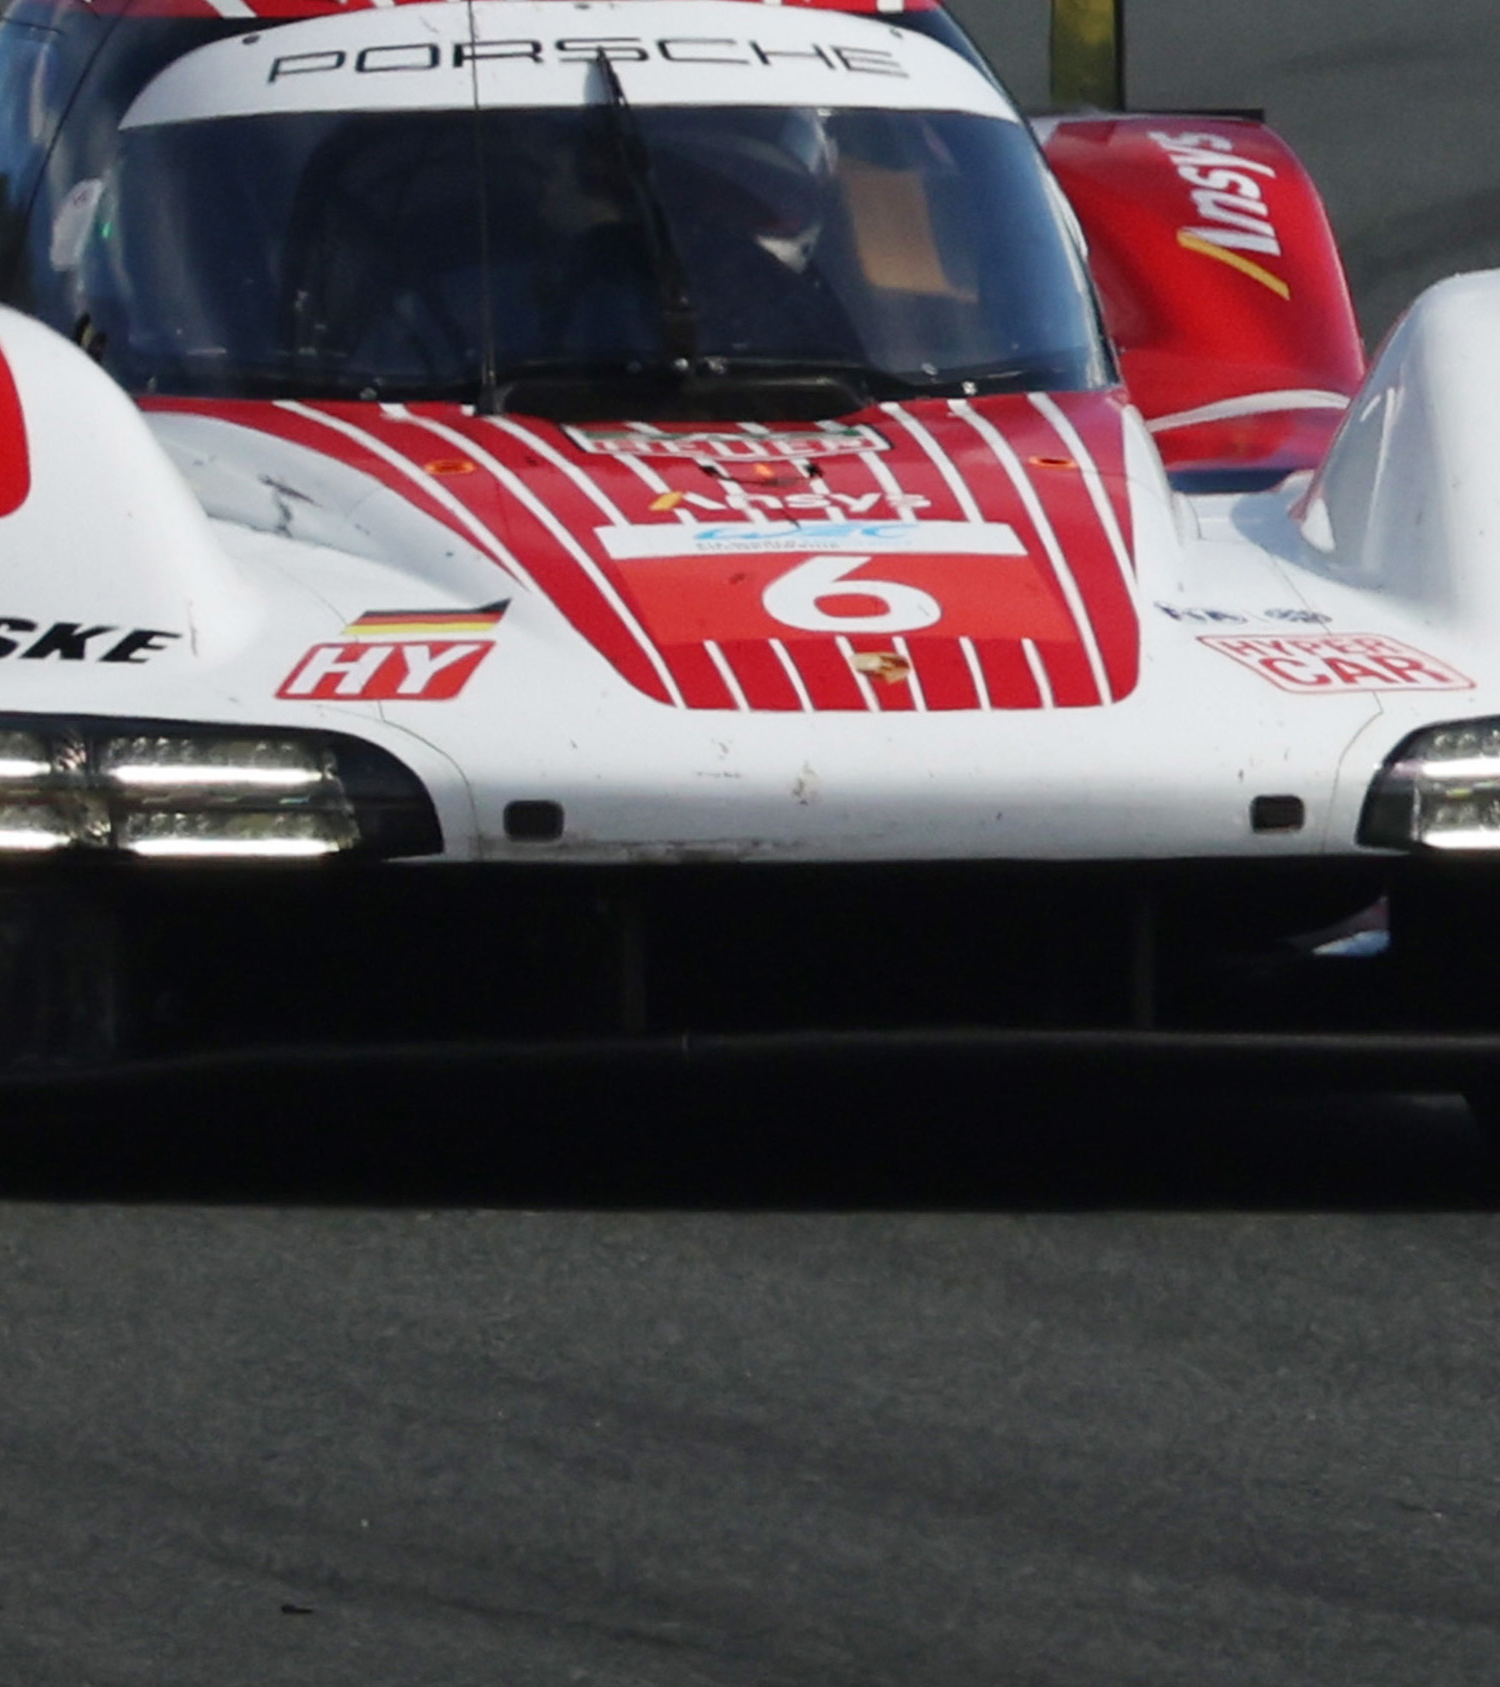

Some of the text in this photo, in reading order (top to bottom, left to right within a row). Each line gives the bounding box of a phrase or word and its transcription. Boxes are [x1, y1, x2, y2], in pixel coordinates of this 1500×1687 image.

[267, 36, 911, 84] PORSCHE
[1149, 131, 1290, 300] Ansys
[762, 555, 942, 634] 6
[283, 645, 455, 697] HY
[1218, 637, 1403, 657] HYPER
[1259, 654, 1454, 686] CAR
